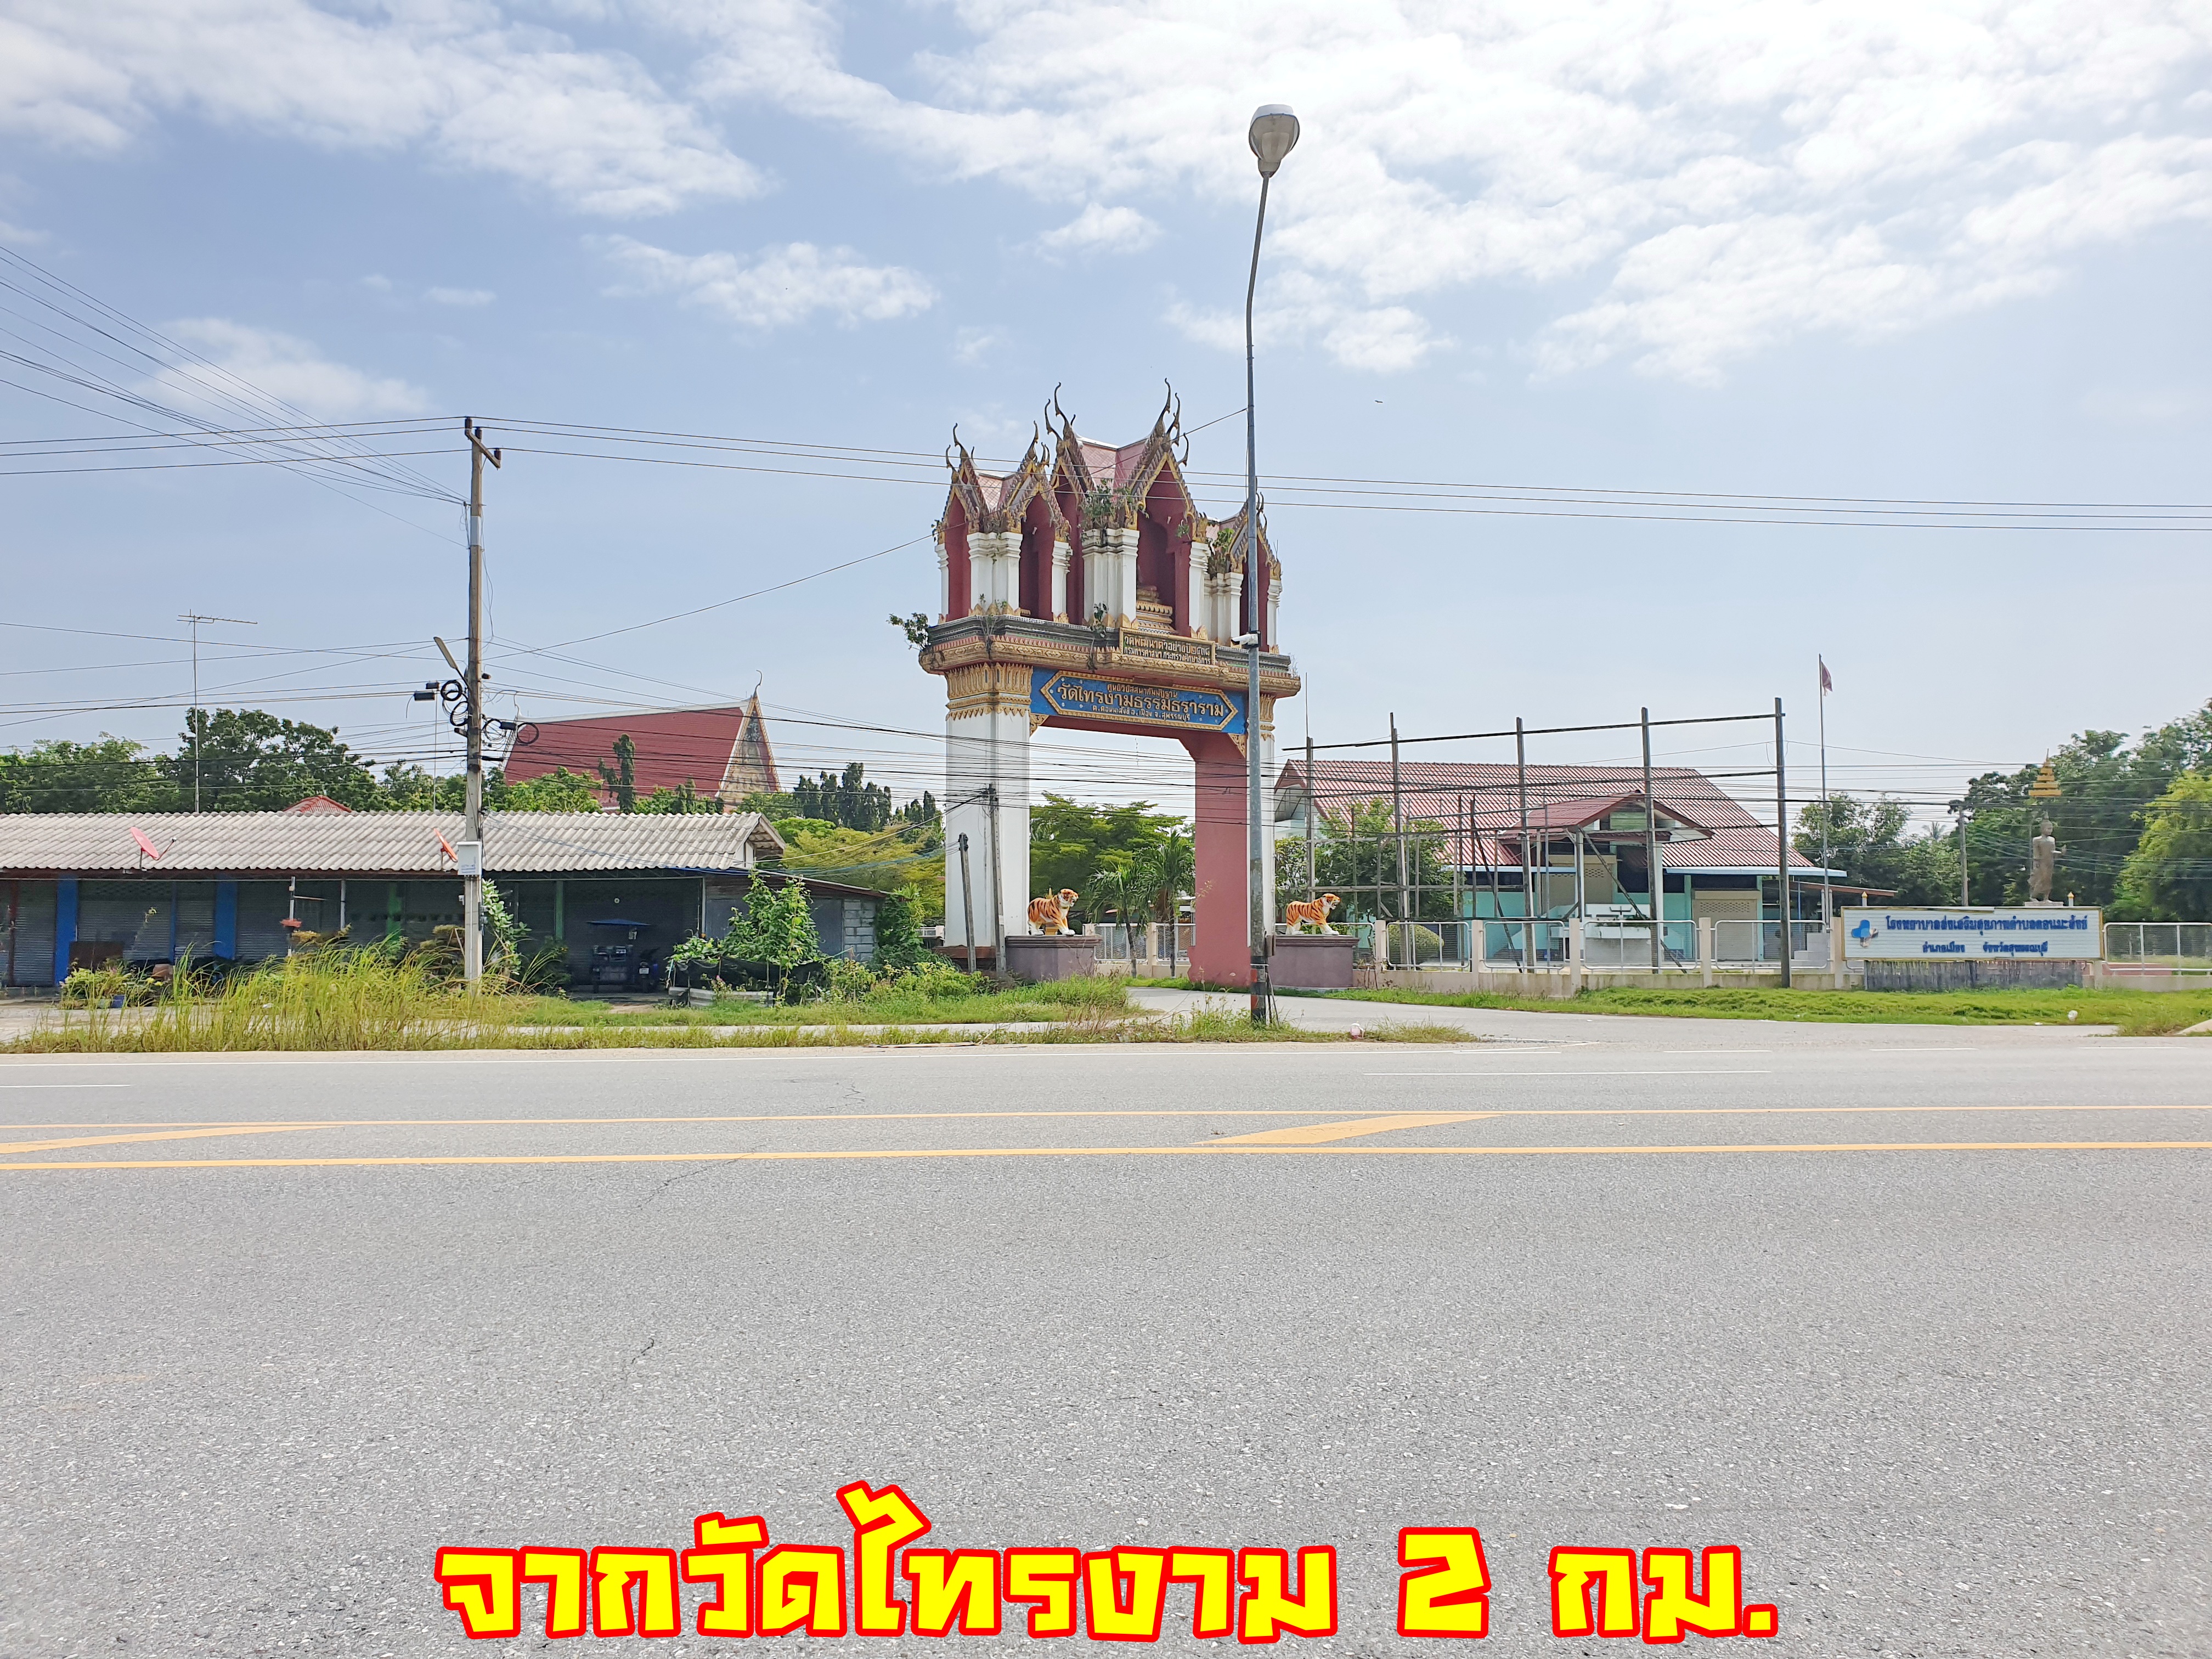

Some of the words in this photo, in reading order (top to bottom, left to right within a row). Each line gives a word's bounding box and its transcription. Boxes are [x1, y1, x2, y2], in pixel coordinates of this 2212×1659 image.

[1124, 646, 1162, 658] กรมการศาสนา
[1163, 651, 1211, 665] กระทรวงศึกษาธิการ
[1057, 682, 1223, 716] วัดไทรงามธรรมธราราม
[1092, 705, 1130, 714] ต.ดอนมะสังข์
[1131, 708, 1152, 718] อ.เมือง
[1154, 711, 1190, 723] จ.สุพรรณบุรี
[1886, 915, 2088, 936] โรงพยาบาลส่งเสริมสุขภาพตำบลดอนมะสังข์
[1922, 941, 1966, 953] อำเภอเมือง
[1983, 940, 2049, 957] จังหวัดสุพรรณบุรี
